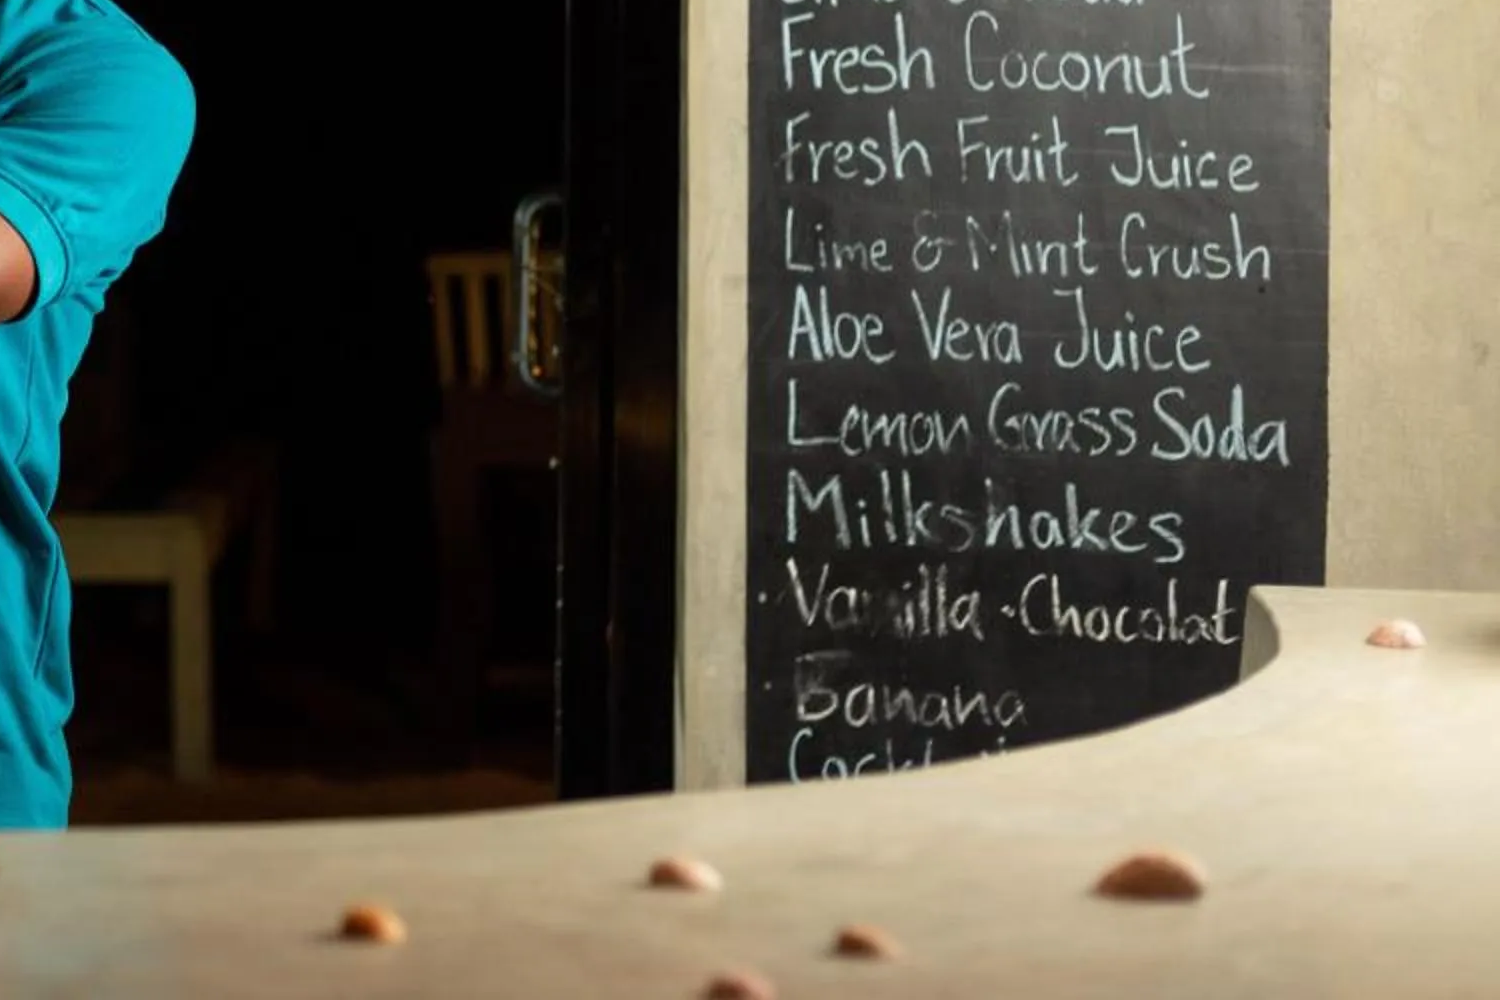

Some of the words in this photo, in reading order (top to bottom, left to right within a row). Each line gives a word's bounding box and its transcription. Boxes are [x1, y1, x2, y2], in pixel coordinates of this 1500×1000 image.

[781, 12, 935, 94] Fresh
[964, 10, 1209, 99] Coconut
[780, 107, 932, 186] Fresh
[956, 115, 1079, 187] Fruit
[1104, 124, 1260, 192] Juice
[785, 206, 894, 274] Lime
[1120, 211, 1271, 281] Crush
[787, 284, 896, 364] Aloe
[912, 286, 1023, 365] Vera
[1052, 286, 1211, 373] Juice
[786, 378, 970, 456] Lemon
[988, 383, 1137, 456] Grass
[1151, 383, 1291, 467] Soda
[786, 468, 1186, 563] Milkshakes
[786, 557, 985, 642] Vailla
[794, 650, 1028, 728] Banana
